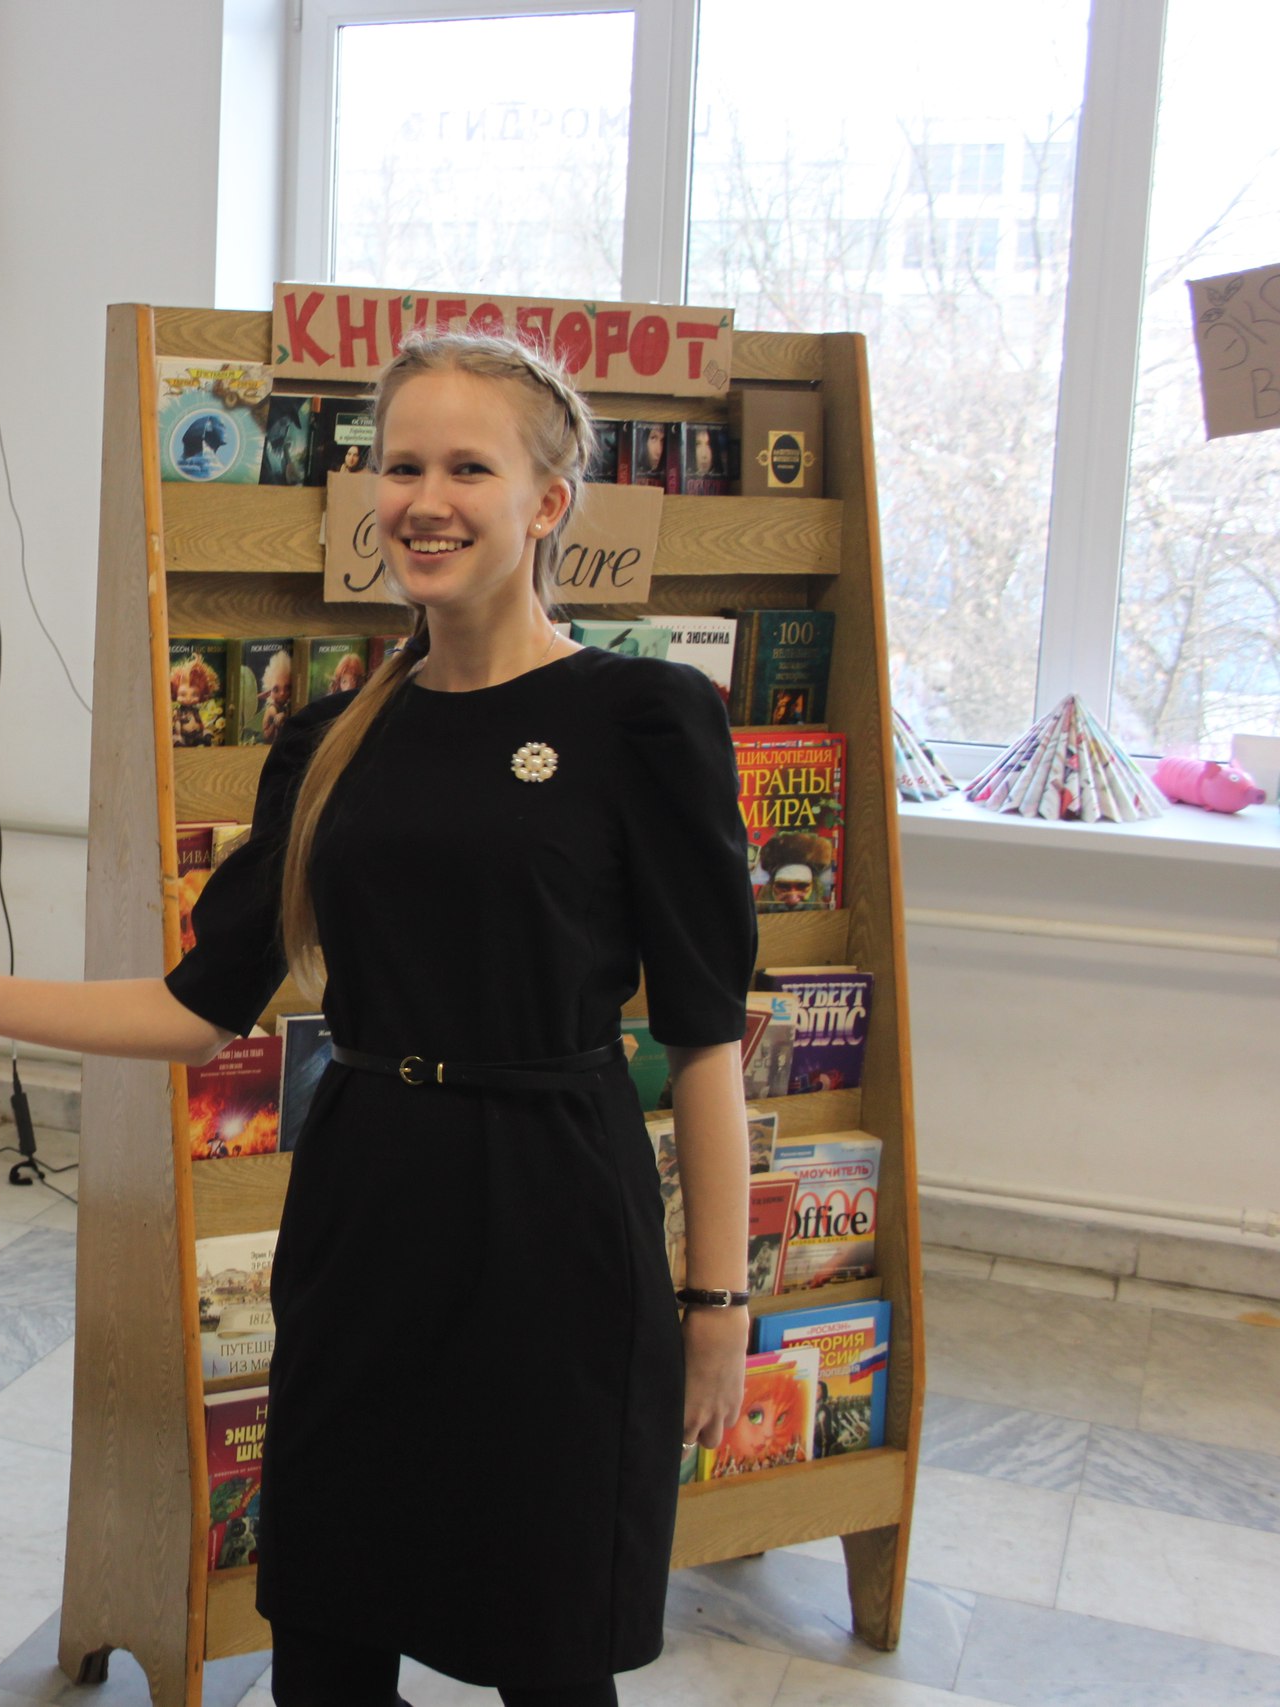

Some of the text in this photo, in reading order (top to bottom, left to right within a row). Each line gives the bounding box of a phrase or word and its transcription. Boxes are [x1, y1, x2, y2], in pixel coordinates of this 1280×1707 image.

[556, 543, 641, 589] are
[686, 631, 730, 645] ЗЮСКИНД
[778, 621, 814, 645] 100
[737, 749, 832, 765] ЦИКЛОПЕДИЯ
[738, 766, 832, 796] ТРАНЫ
[738, 798, 817, 828] МИРА
[793, 1006, 866, 1047] ЭЛЛС
[794, 1165, 870, 1179] МОУЧИТЕЛЬ
[819, 1349, 860, 1367] ССИИ
